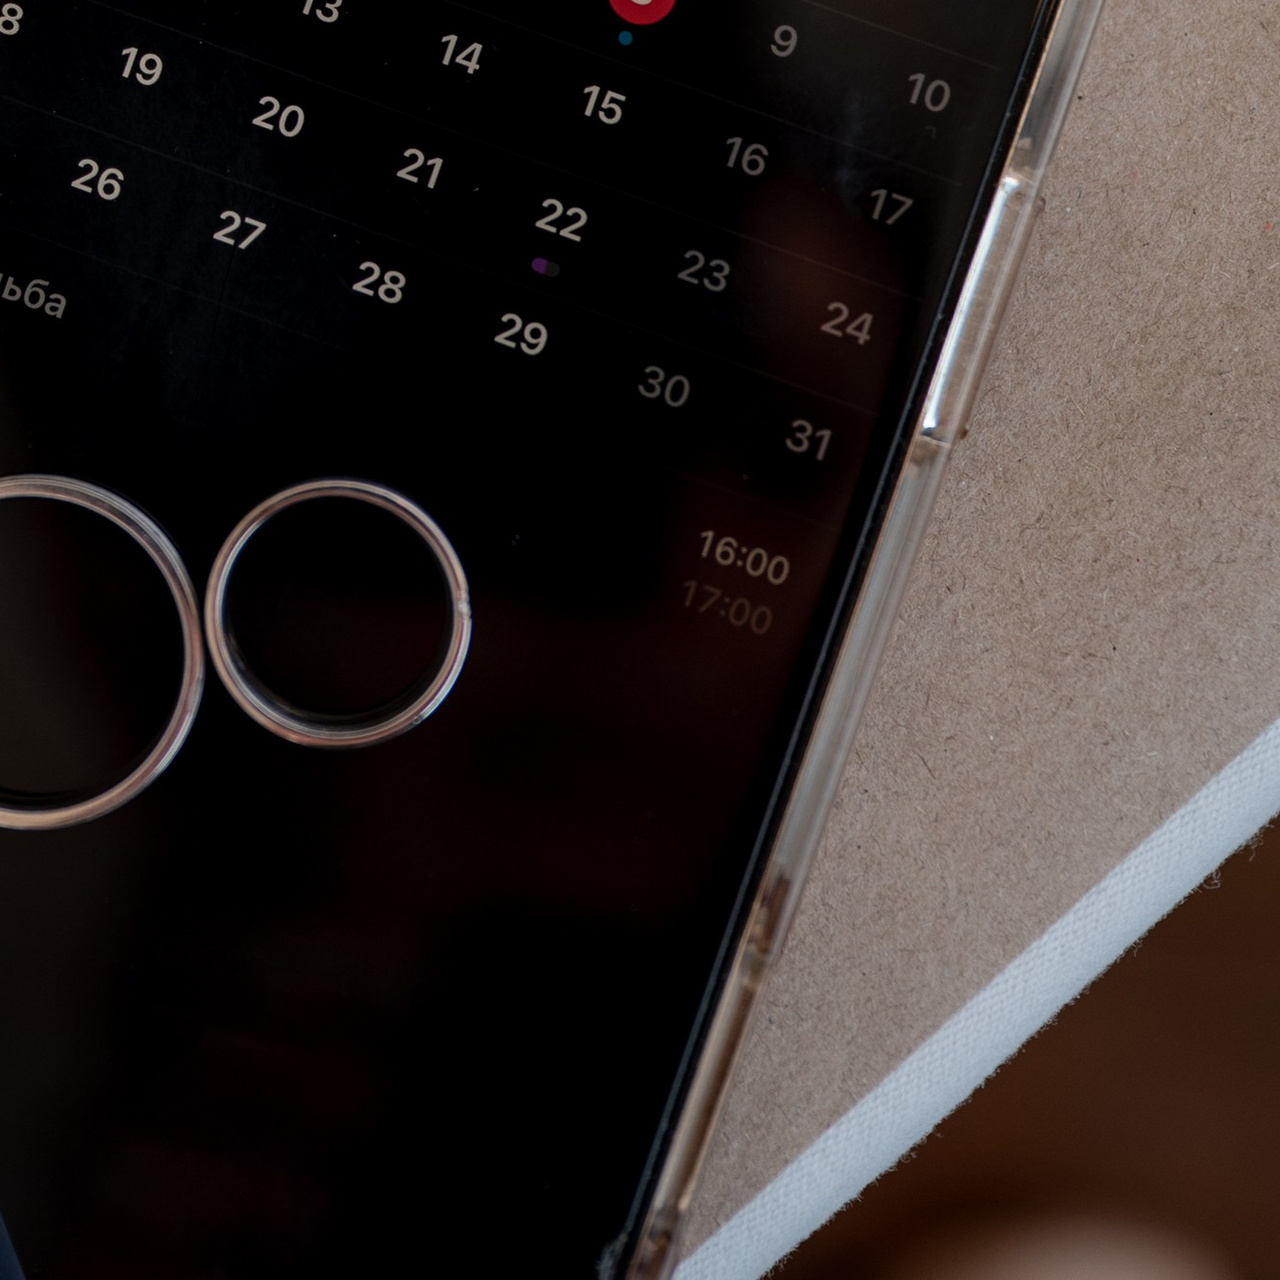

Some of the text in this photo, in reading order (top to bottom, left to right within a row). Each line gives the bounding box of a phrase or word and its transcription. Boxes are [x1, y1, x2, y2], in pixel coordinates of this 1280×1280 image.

[442, 35, 482, 74] 14
[584, 85, 625, 124] 15
[727, 137, 768, 175] 16
[869, 188, 913, 226] 17
[771, 25, 797, 57] 9
[909, 73, 950, 111] 10
[122, 47, 162, 85] 19
[252, 96, 304, 137] 20
[397, 148, 443, 188] 21
[535, 199, 587, 241] 22
[678, 250, 730, 291] 23
[821, 302, 872, 344] 24
[71, 159, 124, 200] 26
[213, 211, 266, 249] 27
[353, 262, 405, 303] 28
[495, 313, 547, 355] 29
[638, 366, 690, 407] 30
[786, 419, 831, 460] 31
[681, 578, 773, 636] 17:00
[699, 529, 790, 586] 16:00
